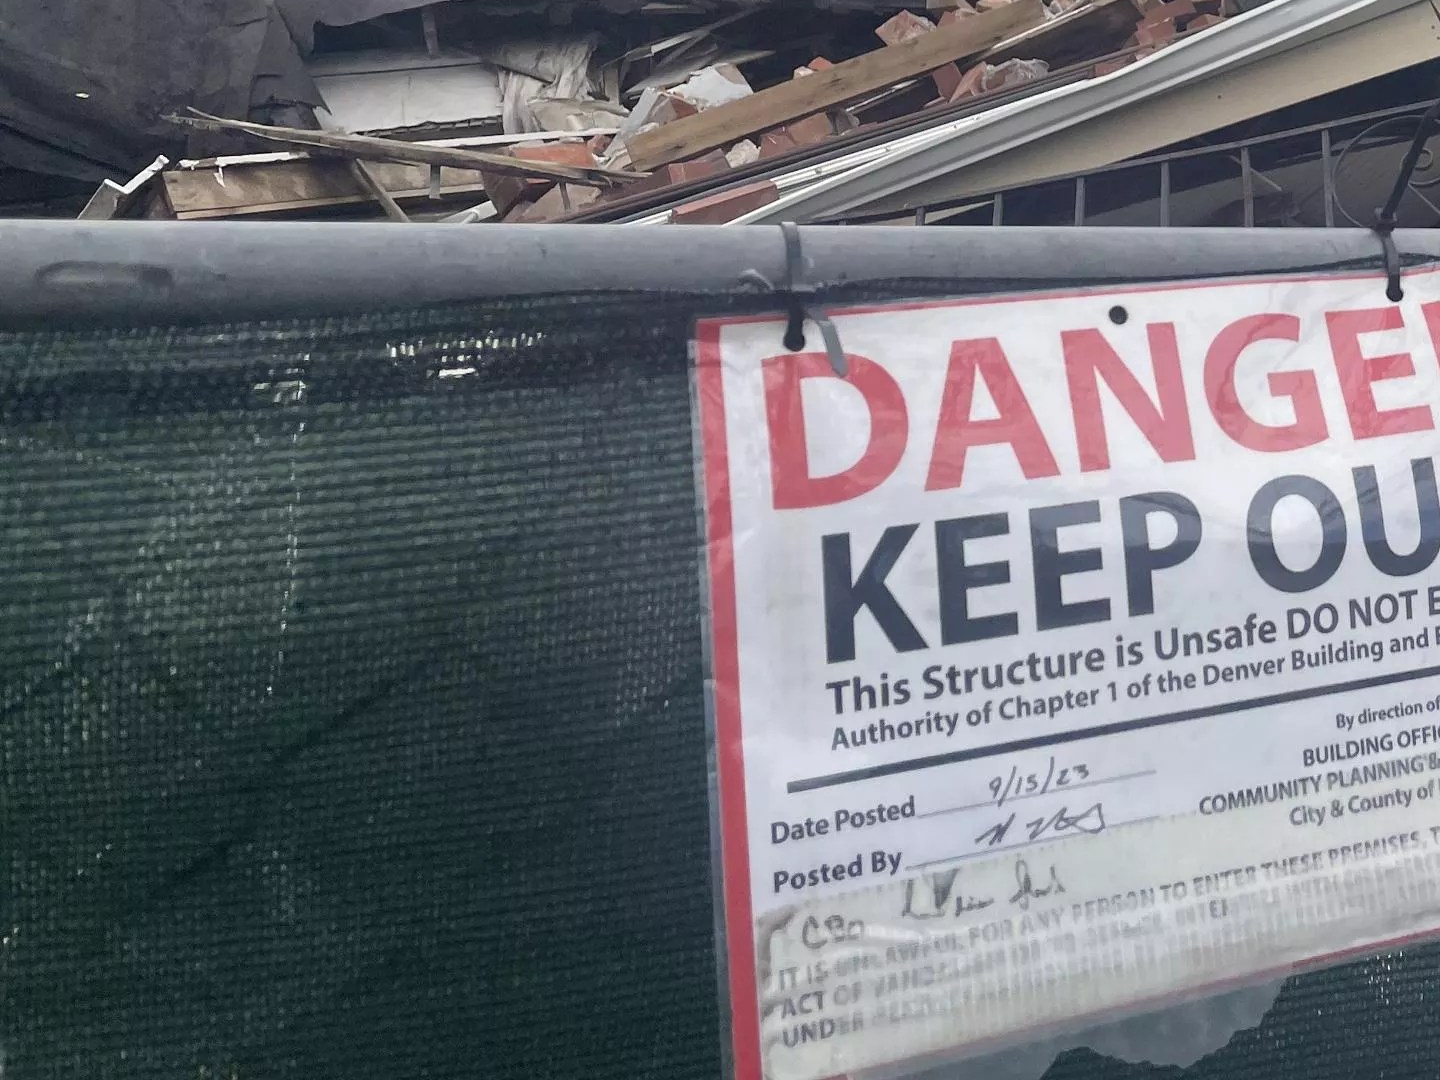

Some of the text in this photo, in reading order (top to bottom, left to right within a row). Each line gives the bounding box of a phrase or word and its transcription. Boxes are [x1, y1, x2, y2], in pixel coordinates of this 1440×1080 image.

[821, 491, 1202, 664] KEEP
[826, 673, 911, 715] This
[923, 646, 1105, 700] Structure
[1116, 634, 1143, 668] is
[1154, 613, 1277, 661] Unsafe
[1286, 603, 1339, 640] DO
[1349, 589, 1418, 629] NOT
[831, 710, 960, 751] Authority
[966, 701, 993, 727] of
[999, 689, 1099, 720] Chapter
[1107, 682, 1118, 702] 1
[1126, 674, 1151, 699] of
[1157, 670, 1197, 694] the
[1203, 656, 1285, 686] Denver
[1291, 639, 1384, 671] Building
[1390, 627, 1429, 653] and
[1336, 695, 1440, 732] By direction of
[1303, 733, 1393, 768] BUILDING
[988, 756, 1091, 807] 9/15/23
[1200, 774, 1322, 816] COMMUNITY
[1327, 754, 1425, 791] PLANNING
[1289, 803, 1326, 826] City
[1330, 799, 1344, 818] &
[1348, 788, 1413, 814] County
[1416, 779, 1435, 800] of
[770, 796, 917, 845] Date Posted
[773, 851, 902, 894] Posted By
[1160, 881, 1187, 903] TO
[781, 990, 824, 1018] ACT
